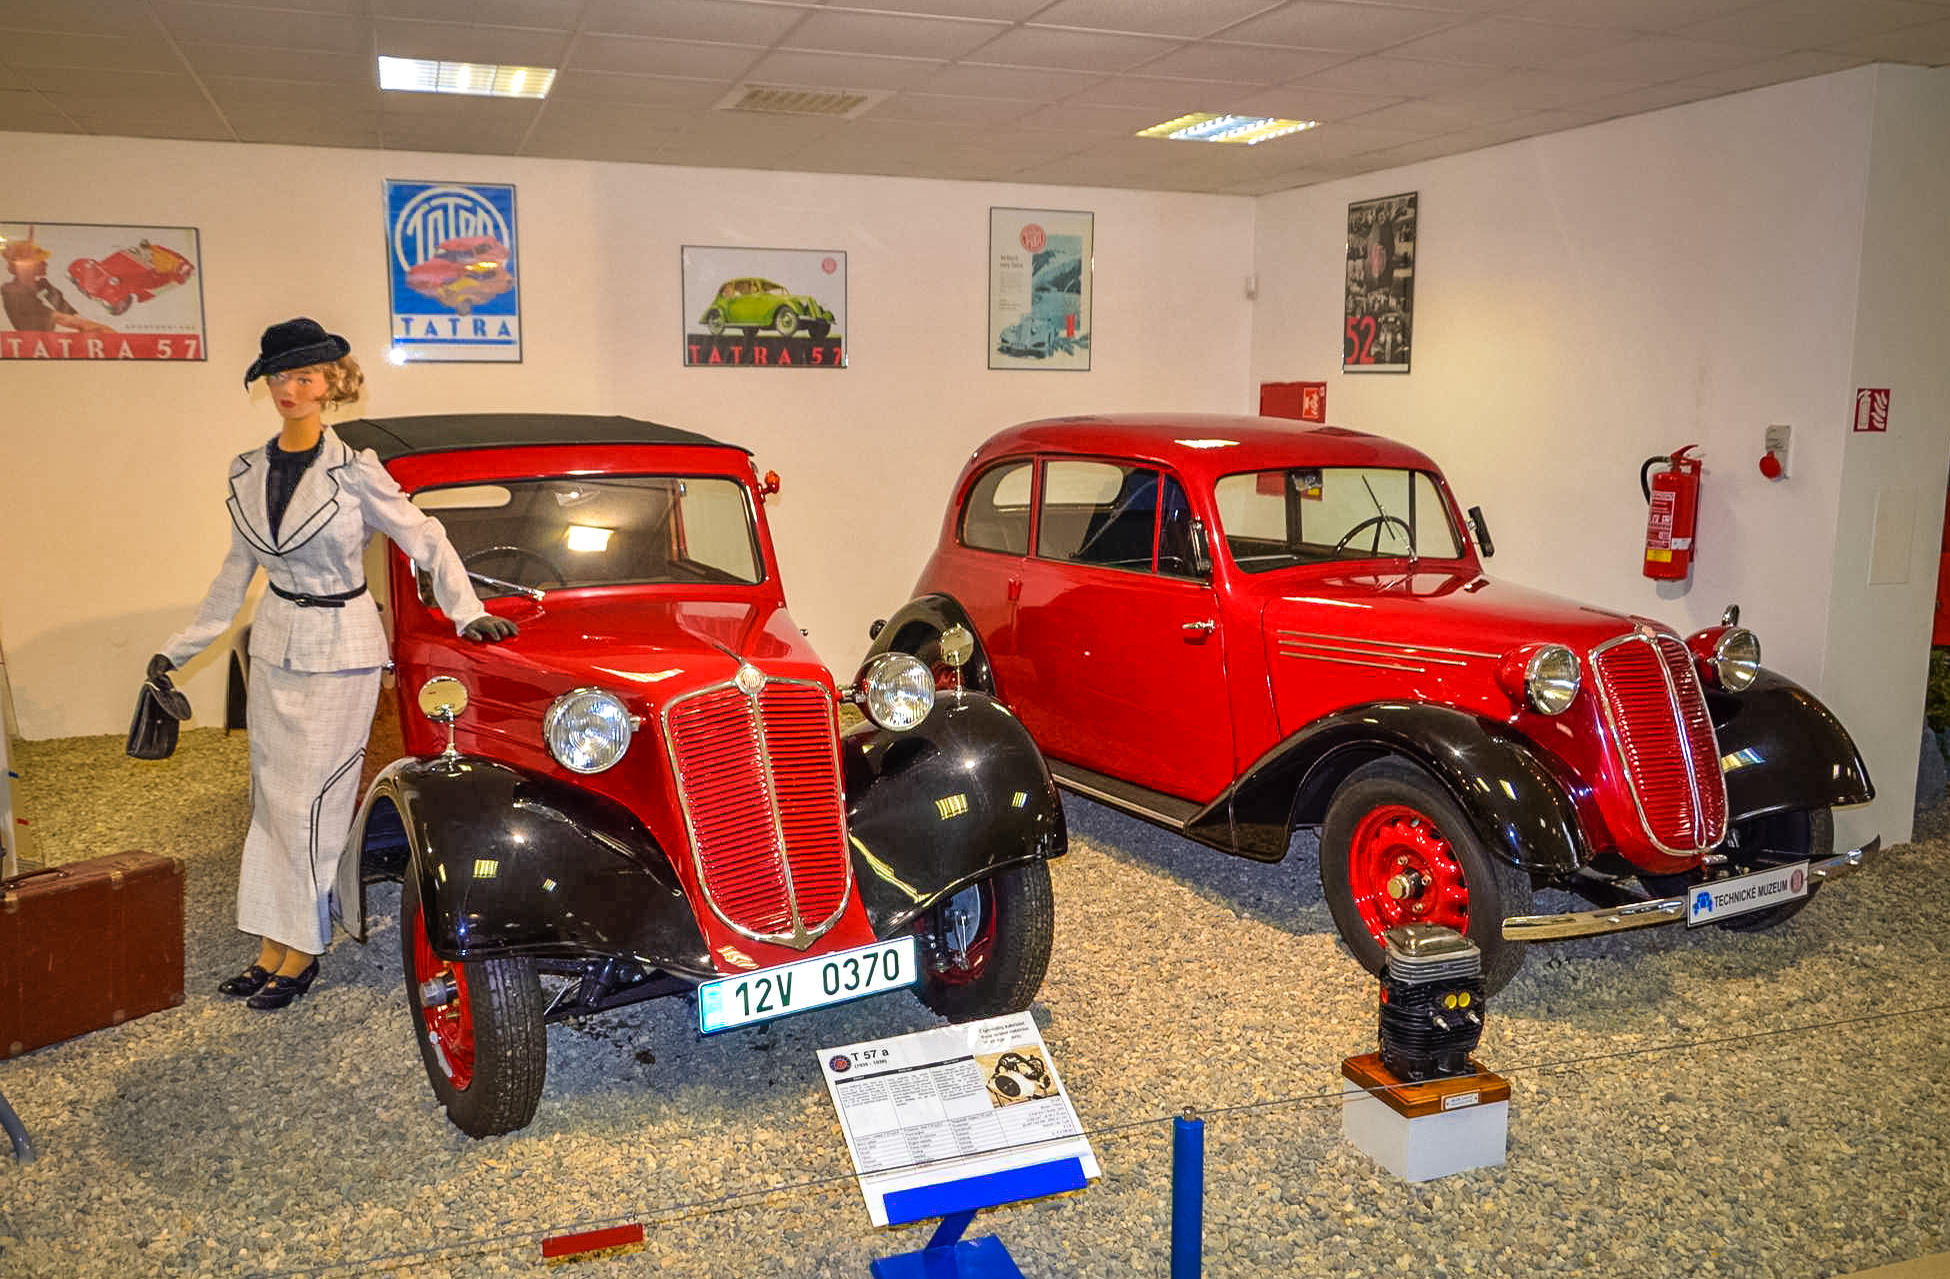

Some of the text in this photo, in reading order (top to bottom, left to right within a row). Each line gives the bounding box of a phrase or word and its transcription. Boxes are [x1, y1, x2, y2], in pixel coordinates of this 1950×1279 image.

[401, 317, 512, 337] TATRA
[8, 338, 198, 359] TATRA 57
[1345, 315, 1377, 365] 52
[688, 344, 843, 366] TATRA 57
[1714, 886, 1757, 908] TECHNICKÉ
[1757, 880, 1788, 897] MUZEUM
[735, 971, 793, 1016] 12V
[822, 948, 900, 996] 0370
[851, 1053, 859, 1061] T
[864, 1050, 877, 1060] 57
